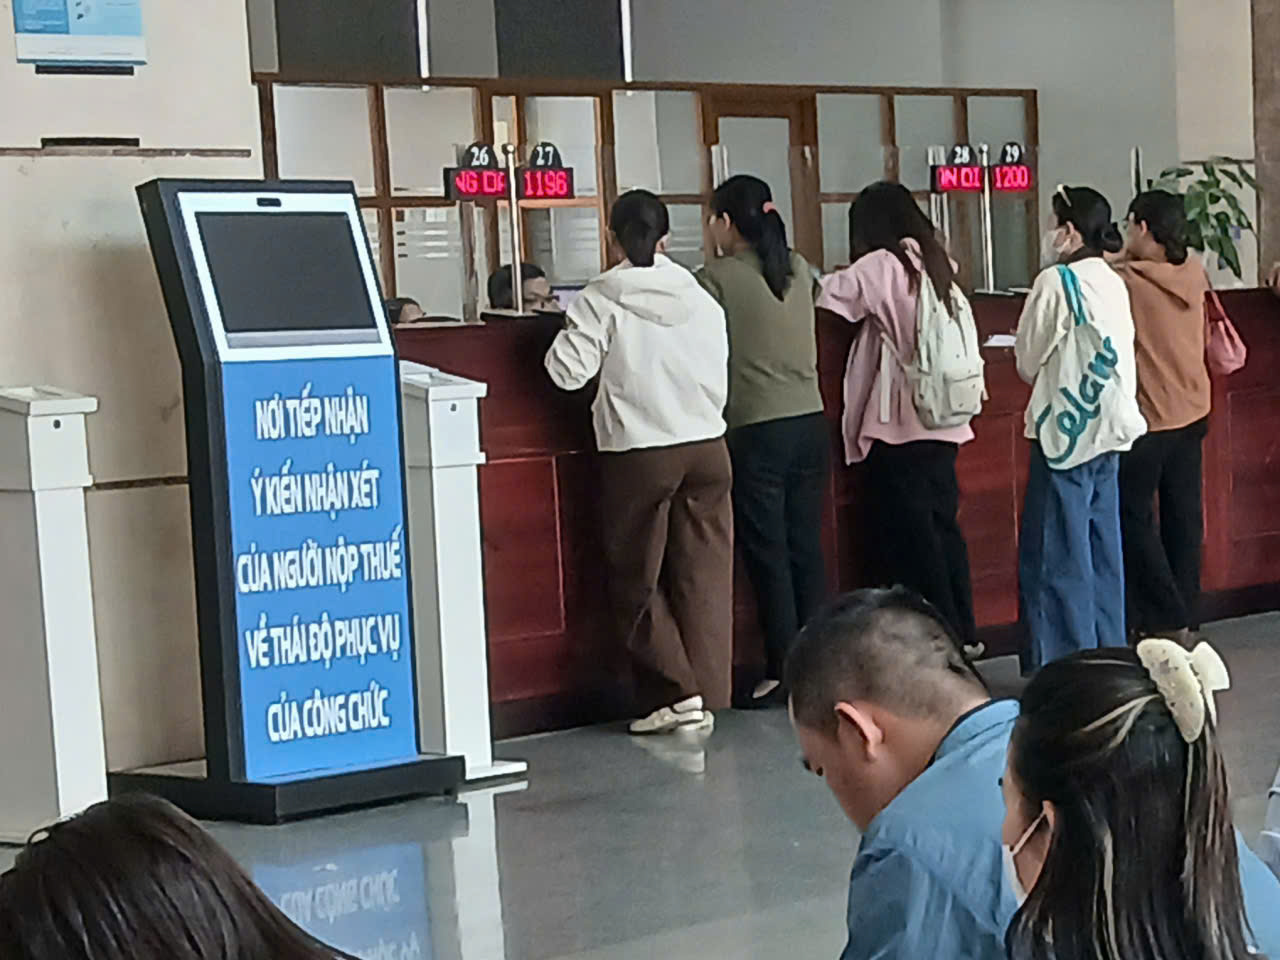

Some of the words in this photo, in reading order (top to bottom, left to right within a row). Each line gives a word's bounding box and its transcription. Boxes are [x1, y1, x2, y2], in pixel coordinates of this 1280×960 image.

[470, 146, 489, 166] 26
[536, 146, 554, 166] 27
[954, 145, 970, 164] 28
[1005, 145, 1020, 162] 29
[525, 170, 568, 196] 1196
[995, 165, 1028, 188] 1200
[286, 381, 322, 438] TIẾP
[324, 385, 369, 445] NHẬN
[251, 467, 263, 516] Ý
[265, 458, 303, 515] KIẾN
[304, 462, 349, 520] NHẬN
[350, 459, 380, 509] XÉT
[237, 542, 272, 593] CỦA
[273, 539, 323, 591] NGƯỜI
[325, 536, 359, 593] NỘP
[360, 524, 402, 582] THUẾ
[245, 612, 270, 669] VỀ
[270, 614, 307, 666] THÁI
[309, 611, 333, 670] ĐỘ
[335, 616, 377, 665] PHỤC
[377, 613, 400, 661] VỤ
[267, 691, 302, 742] CỦA
[303, 688, 347, 737] CÔNG
[348, 680, 390, 731] CHỨC
